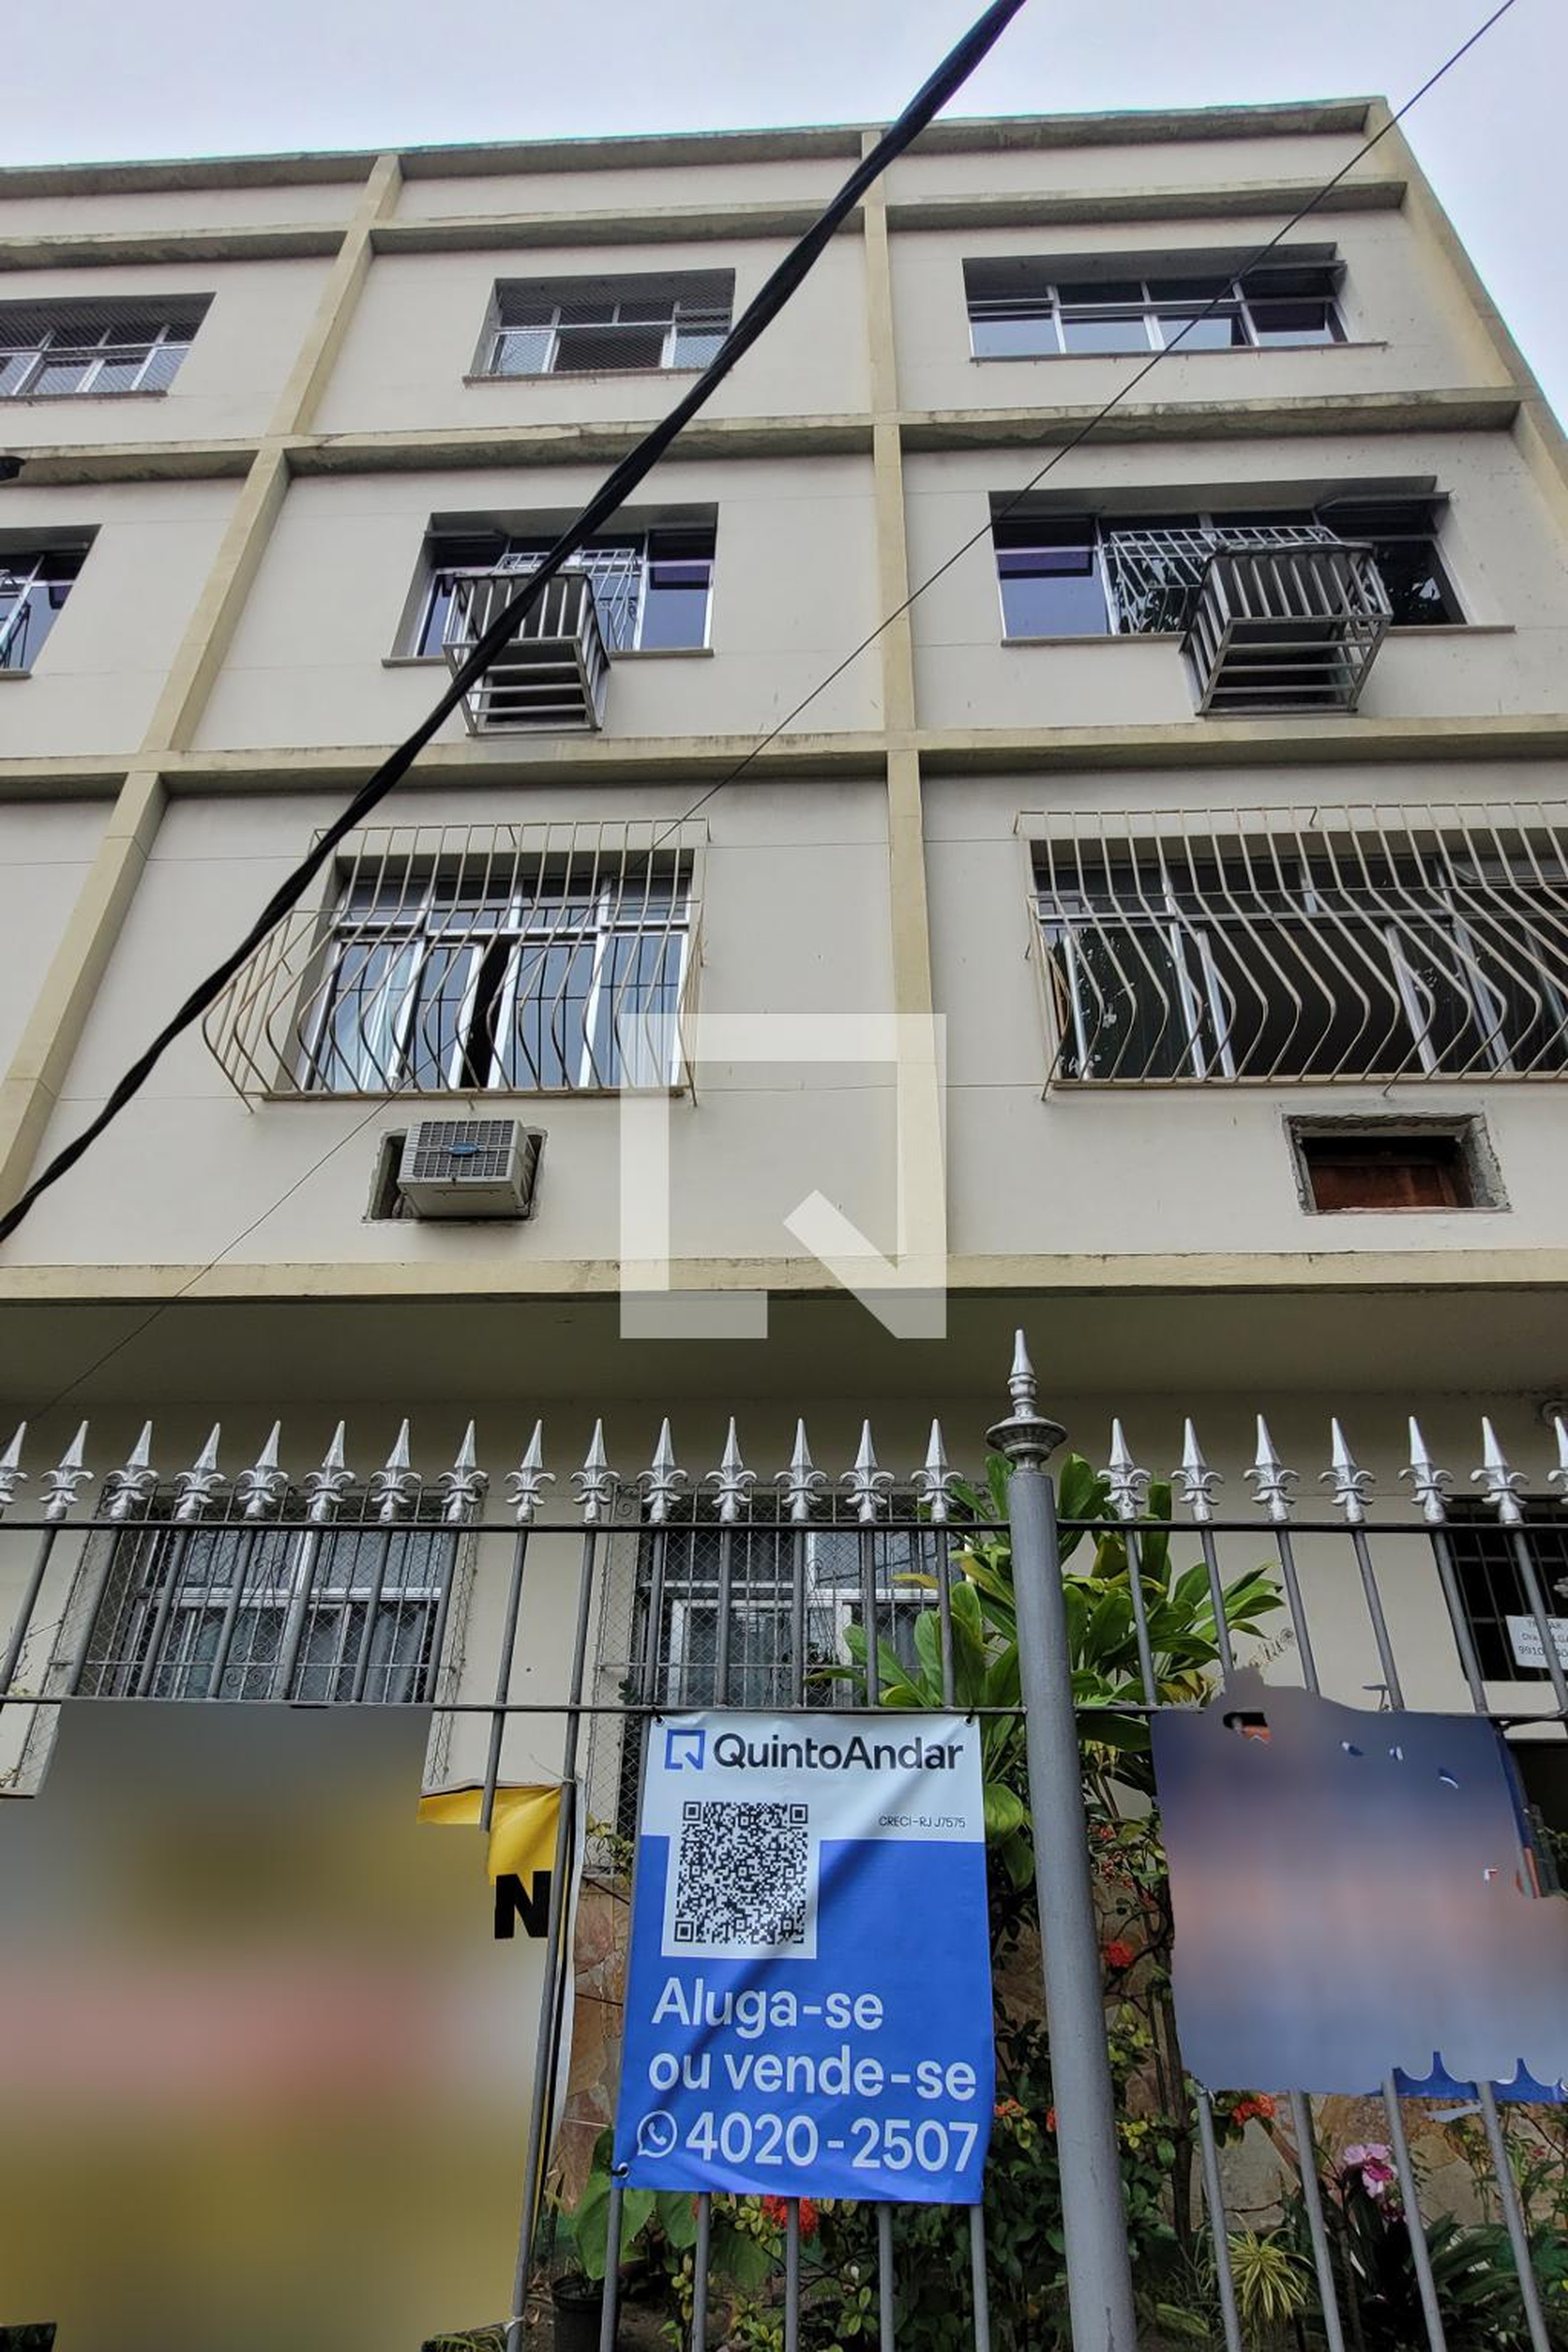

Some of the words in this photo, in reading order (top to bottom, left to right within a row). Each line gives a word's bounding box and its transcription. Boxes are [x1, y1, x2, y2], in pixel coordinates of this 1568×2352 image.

[713, 1733, 964, 1770] QuintoAndar
[878, 1815, 932, 1827] CRECI-RJ
[933, 1817, 966, 1828] J7575
[652, 1977, 883, 2039] Aluga-se
[649, 2052, 710, 2090] ou
[724, 2045, 976, 2101] vende-se
[686, 2112, 978, 2172] 4020-2507
